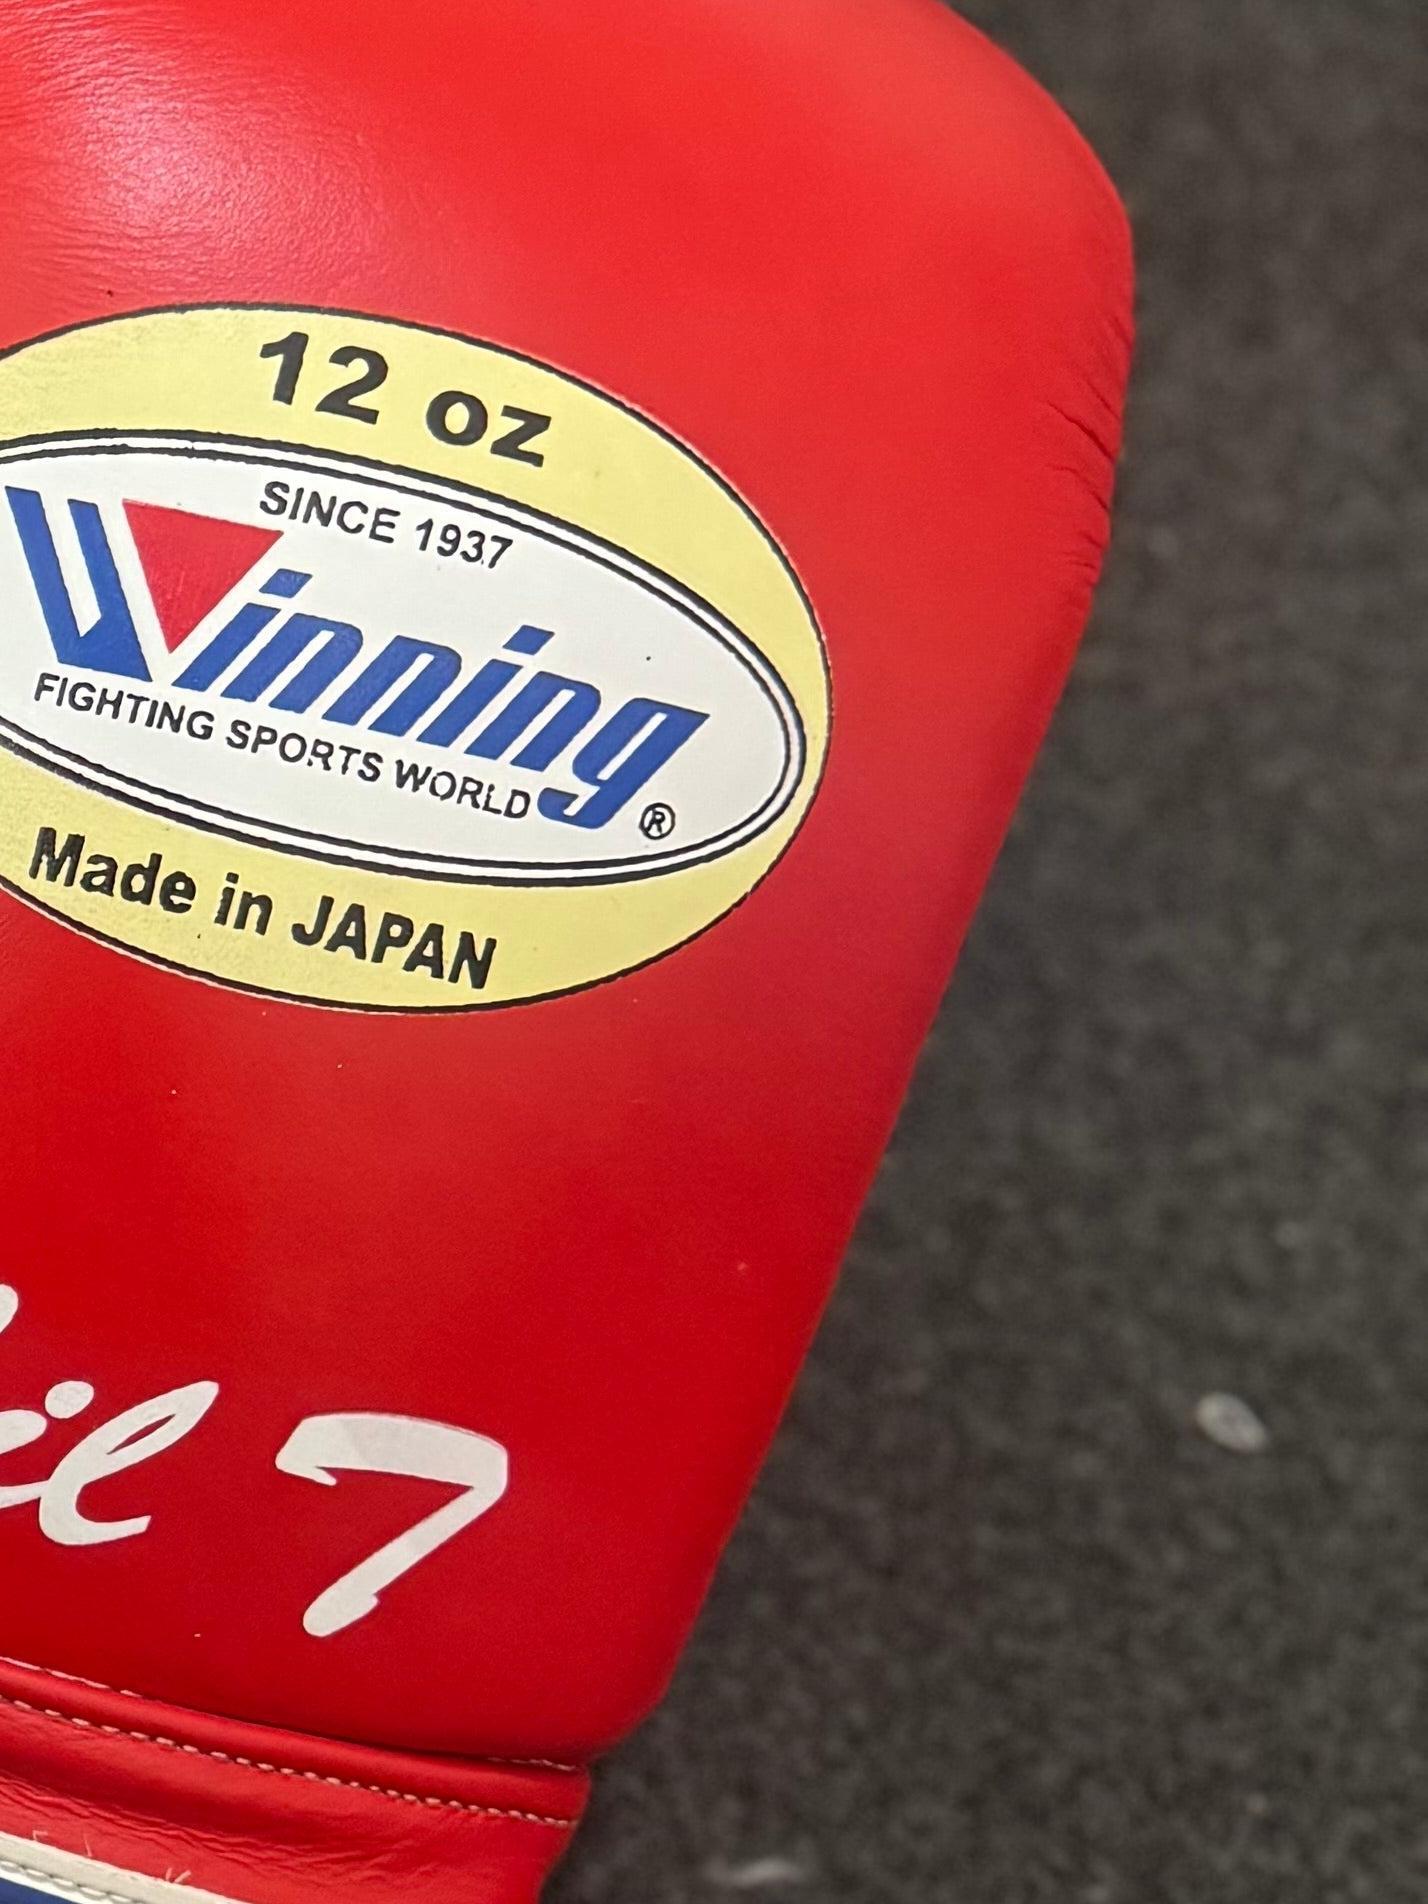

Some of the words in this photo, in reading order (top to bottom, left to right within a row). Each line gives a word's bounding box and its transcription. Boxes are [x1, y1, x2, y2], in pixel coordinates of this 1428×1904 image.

[260, 332, 388, 424] 12
[427, 391, 551, 467] oz
[260, 481, 400, 543] SINCE
[417, 519, 513, 568] 1937
[5, 485, 710, 830] Winning
[35, 673, 214, 740] FIGHTING
[226, 720, 383, 782] SPORTS
[396, 760, 530, 818] WORLD
[29, 827, 196, 913] Made
[215, 872, 272, 935] in
[292, 896, 496, 989] JAPAN
